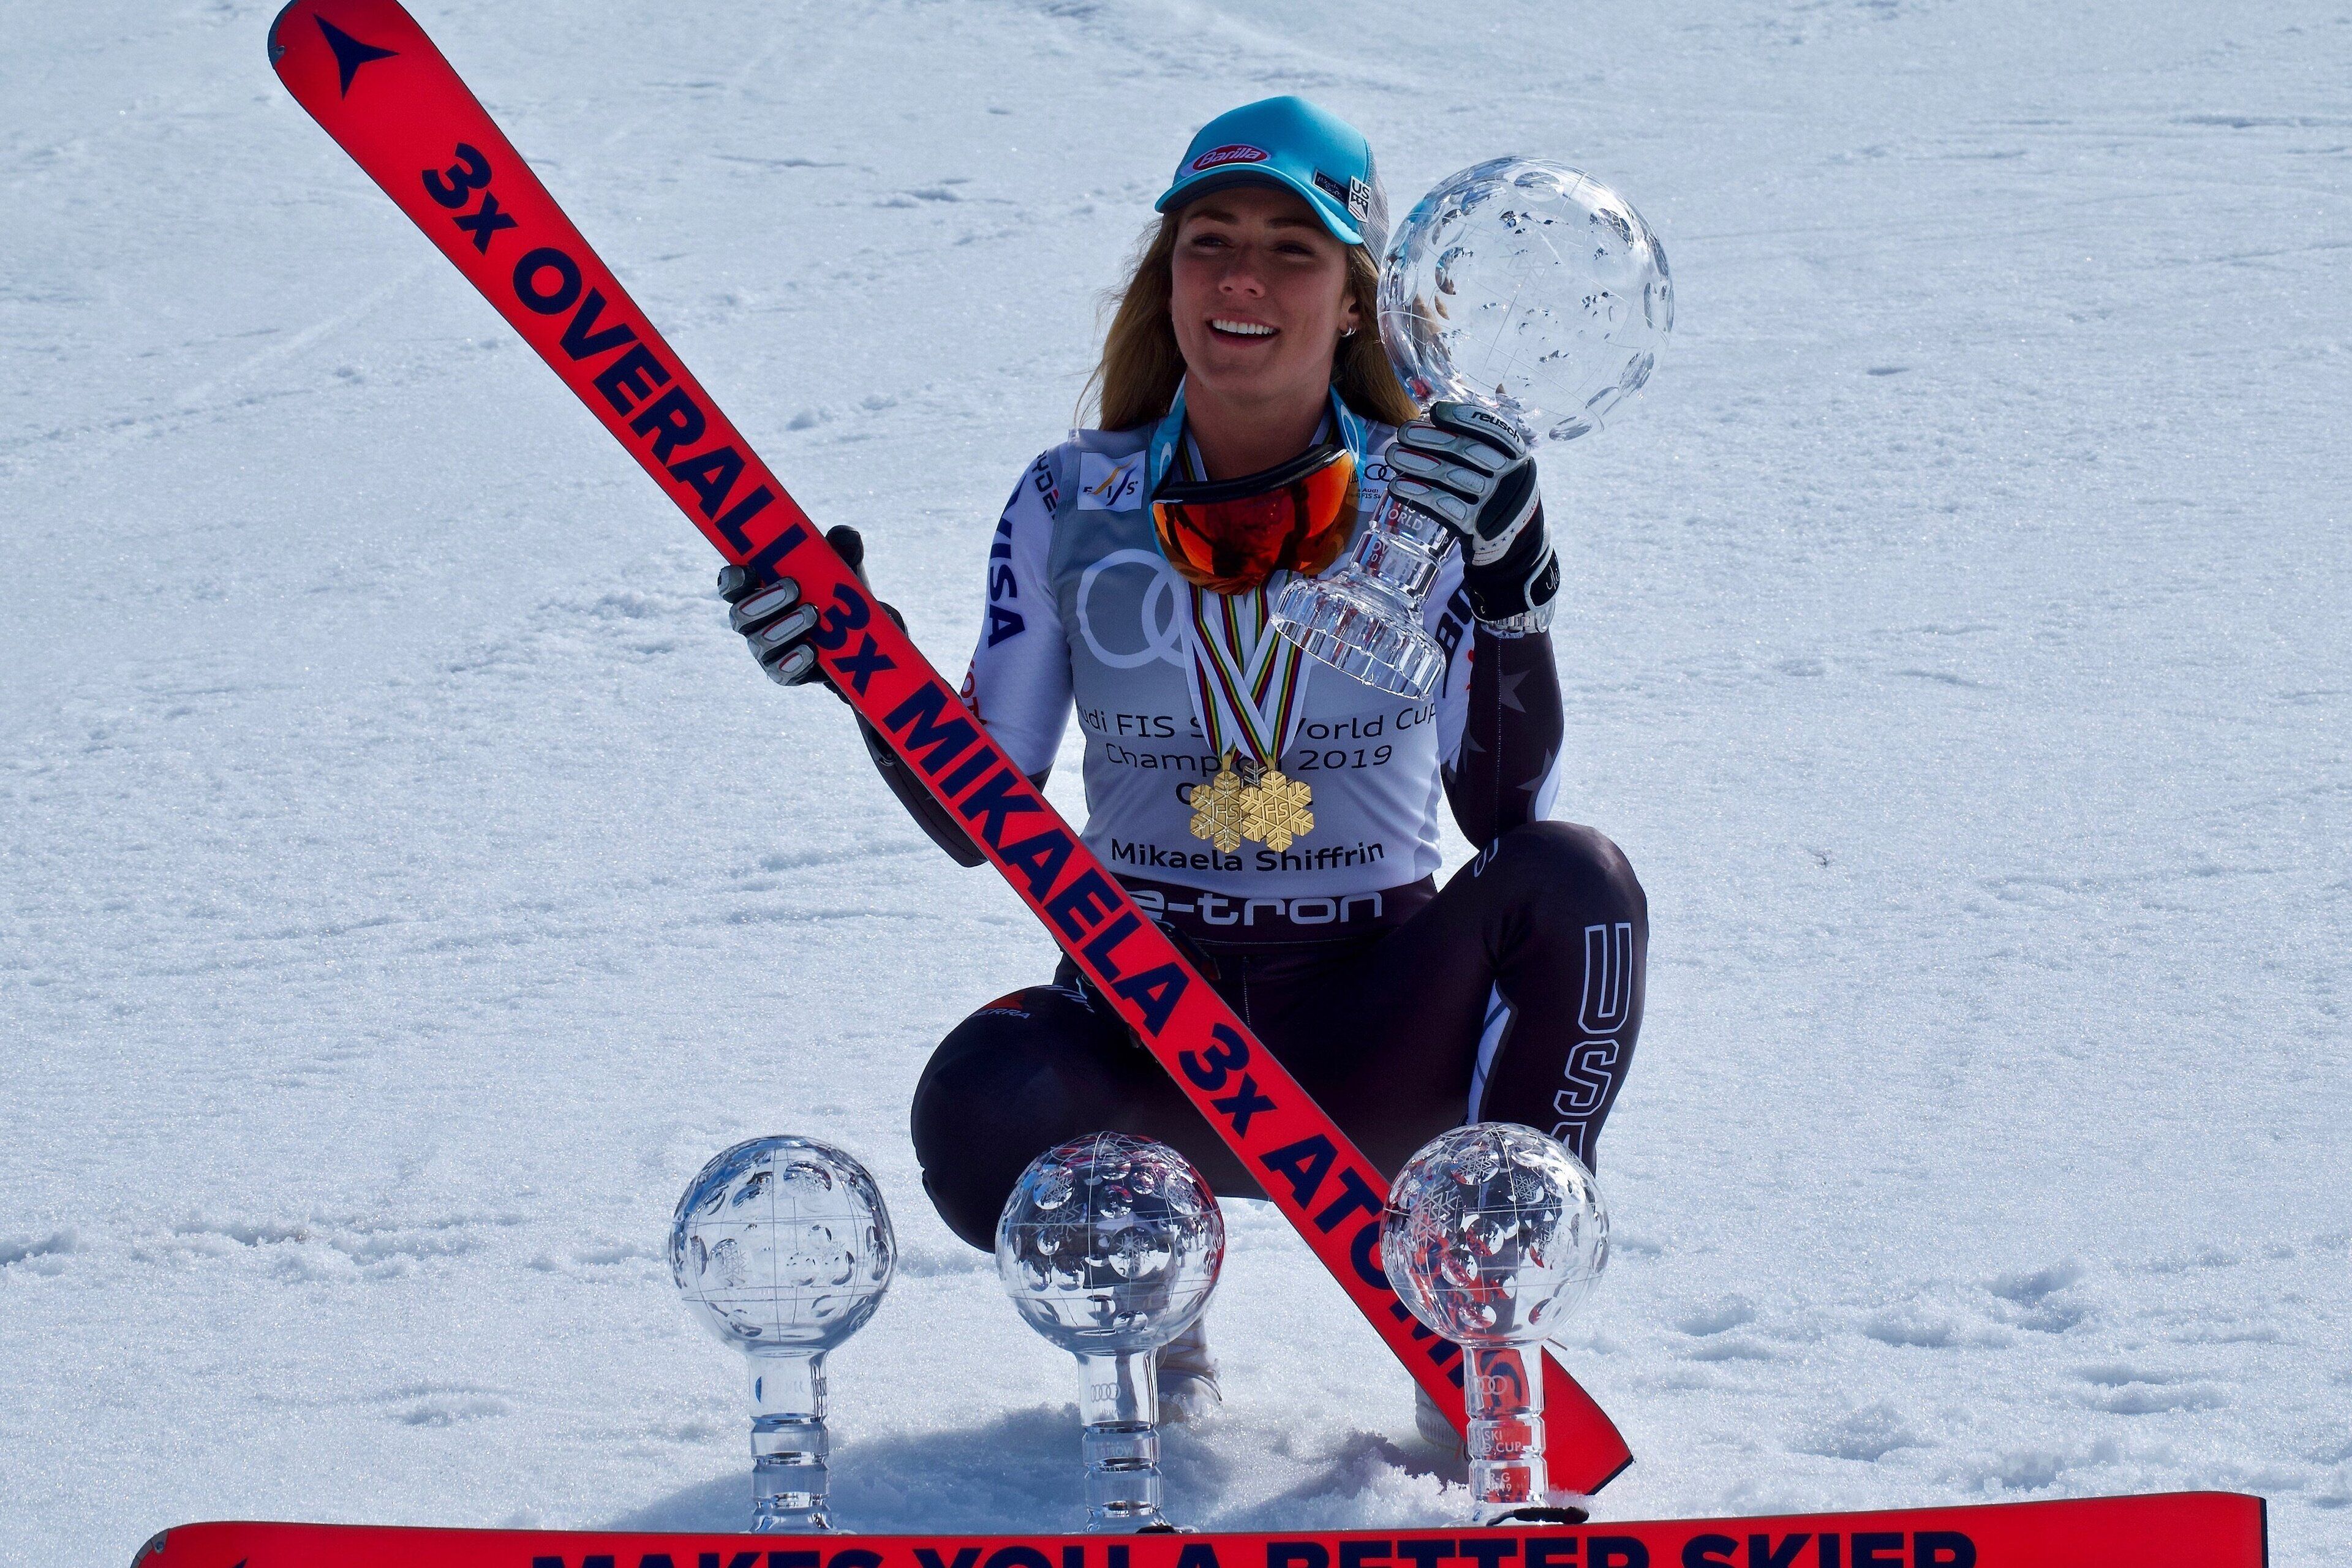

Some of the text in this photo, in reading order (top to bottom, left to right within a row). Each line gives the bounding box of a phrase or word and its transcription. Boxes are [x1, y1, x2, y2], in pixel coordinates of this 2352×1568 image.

[1197, 148, 1261, 168] Barilla
[1352, 179, 1370, 200] US
[1471, 411, 1520, 443] reusch
[1379, 505, 1423, 531] ORLD
[421, 142, 519, 256] 3x
[513, 247, 809, 584] OVERALL
[810, 582, 899, 698] 3x
[883, 680, 1190, 1038] MIKAELA
[1178, 1022, 1278, 1139] 3x
[1078, 706, 1107, 733] udi
[1116, 714, 1175, 739] FIS
[1294, 715, 1384, 740] orld
[1298, 745, 1392, 771] 2019
[1111, 839, 1384, 872] Mikaela Shiffrin
[1126, 890, 1382, 926] e-tron
[1484, 1430, 1502, 1441] SKI
[1496, 1441, 1521, 1453] CUP
